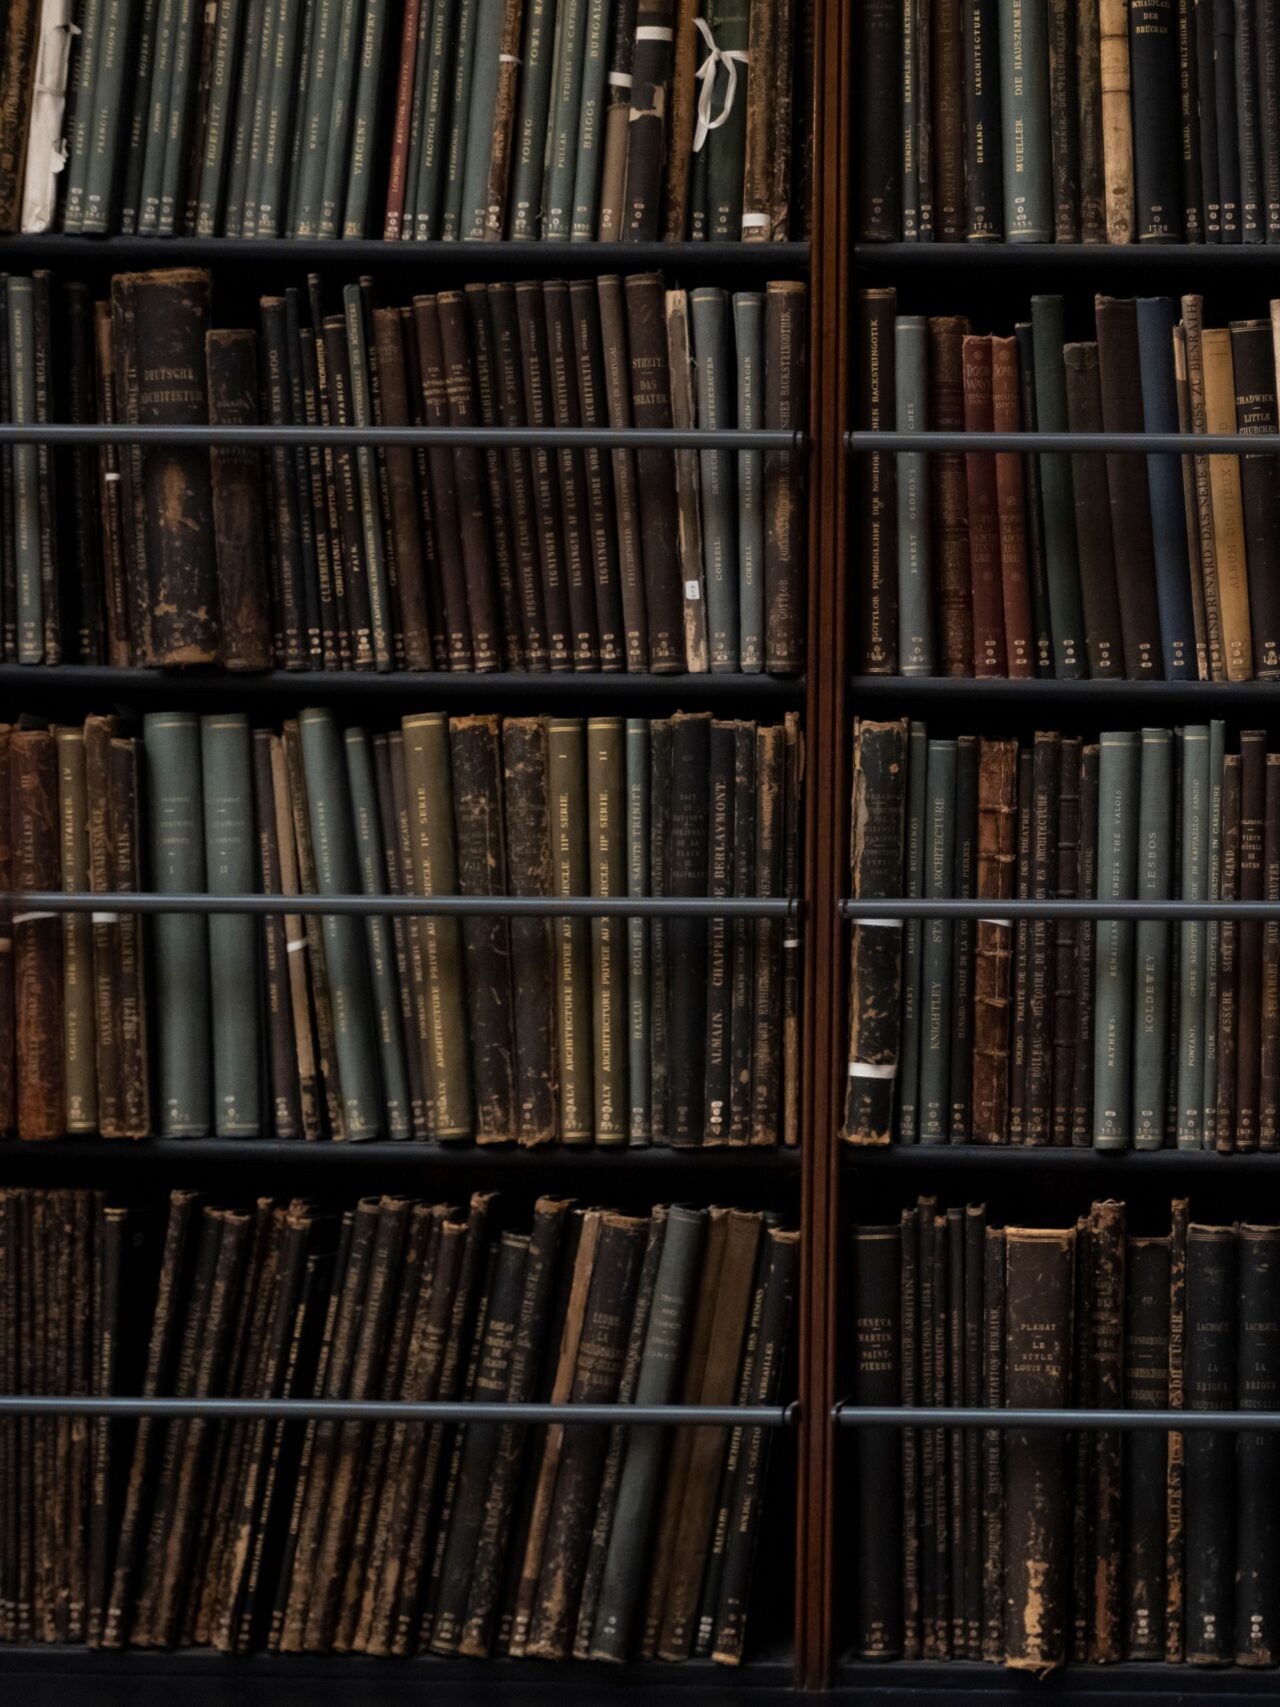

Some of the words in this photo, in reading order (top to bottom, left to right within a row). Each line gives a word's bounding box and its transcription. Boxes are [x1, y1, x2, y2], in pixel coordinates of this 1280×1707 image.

[1179, 17, 1189, 68] WILTSHIRE
[206, 102, 222, 167] TRUEFITT.
[214, 26, 229, 85] COUNTRY
[353, 115, 367, 175] VINCENT.
[362, 12, 376, 67] COUNTRY
[522, 115, 534, 164] YOUNG.
[529, 28, 540, 67] TOWN
[562, 61, 573, 100] STUDIES
[1014, 76, 1023, 96] DIE
[583, 97, 596, 149] BRIGGS.
[1186, 303, 1202, 371] BENRATH
[1243, 413, 1270, 423] LITTLE
[932, 797, 944, 889] ARCHITECTURE
[1112, 831, 1121, 853] THE
[1147, 831, 1157, 888] LESBOS
[1111, 860, 1121, 896] UNDER
[930, 981, 943, 1050] KNIGHTLEY
[1145, 952, 1156, 1033] KOLDEWEY.
